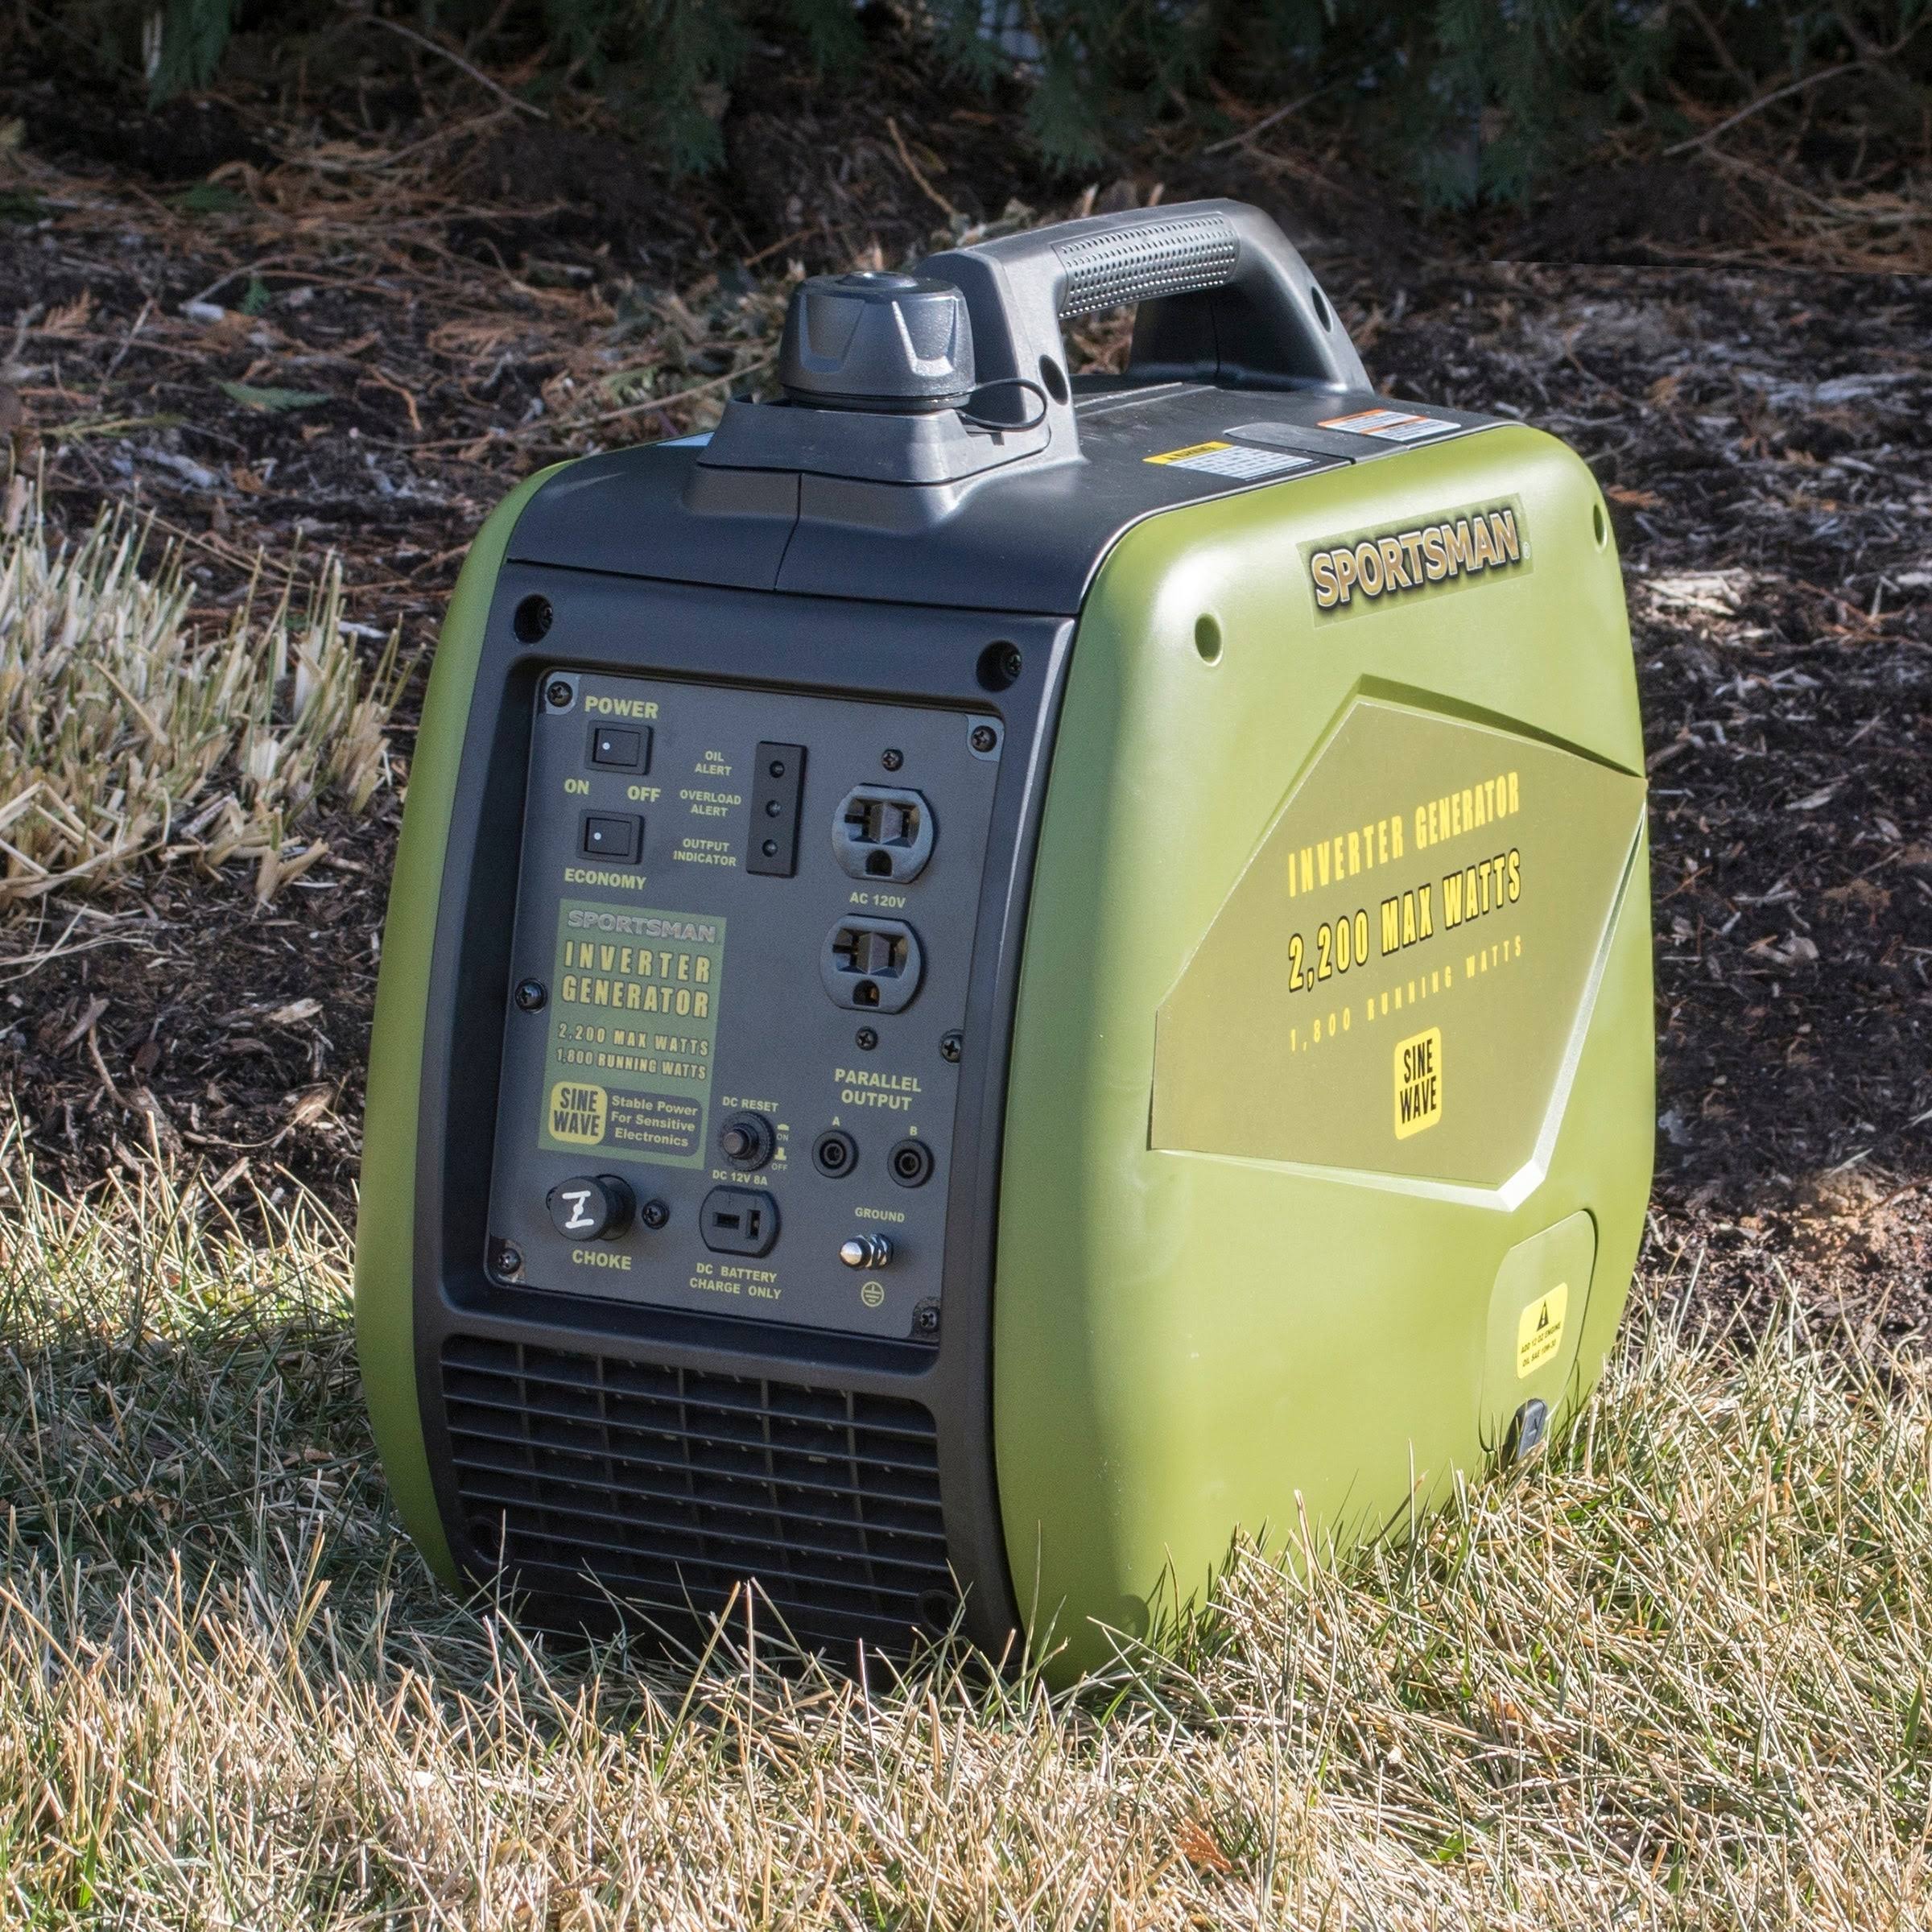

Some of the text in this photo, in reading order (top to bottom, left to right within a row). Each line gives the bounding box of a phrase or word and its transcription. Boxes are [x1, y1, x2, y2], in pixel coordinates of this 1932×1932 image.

[1311, 510, 1520, 607] SPORTSMAN
[585, 696, 658, 719] POWER
[705, 751, 724, 762] OIL
[695, 763, 732, 776] ALERT
[565, 779, 589, 795] ON
[628, 786, 661, 803] OFF
[679, 790, 741, 805] OVERLOAD
[691, 804, 729, 817] ALERT
[683, 838, 730, 852] OUTPUT
[1289, 771, 1519, 898] INVERTER GENERATOR
[673, 850, 737, 866] INDICATOR
[565, 869, 646, 890] ECONOMY
[849, 892, 906, 909] AC 120V
[568, 910, 716, 943] SPORTSMAN
[1289, 848, 1521, 993] 2,200 MAX WATTS
[564, 940, 711, 984] INVERTER
[562, 975, 709, 1018] GENERATOR
[1290, 935, 1521, 1051] 1,800 RUNNING WATTS
[558, 1022, 708, 1057] 2,200 MAX WATTS
[597, 1053, 657, 1073] RUNNING
[662, 1060, 707, 1080] WATTS
[1403, 1038, 1433, 1084] SINE
[835, 1068, 921, 1092] PARALLEL
[560, 1088, 598, 1113] SINE
[612, 1096, 698, 1116] Stable Power
[723, 1096, 778, 1113] DC RESET
[841, 1089, 912, 1111] OUTPUT
[1400, 1075, 1437, 1125] WAVE
[553, 1110, 601, 1137] WAVE
[611, 1111, 696, 1132] For Sensitive
[832, 1117, 841, 1126] A
[910, 1126, 918, 1136] B
[615, 1127, 688, 1147] Electronics
[777, 1133, 789, 1141] ON
[771, 1162, 787, 1171] OFF
[712, 1170, 768, 1186] DC 12V 8A
[855, 1207, 905, 1223] GROUND
[572, 1249, 632, 1270] CHOKE
[696, 1262, 777, 1283] DC BATTERY
[690, 1278, 782, 1299] CHARGE ONLY
